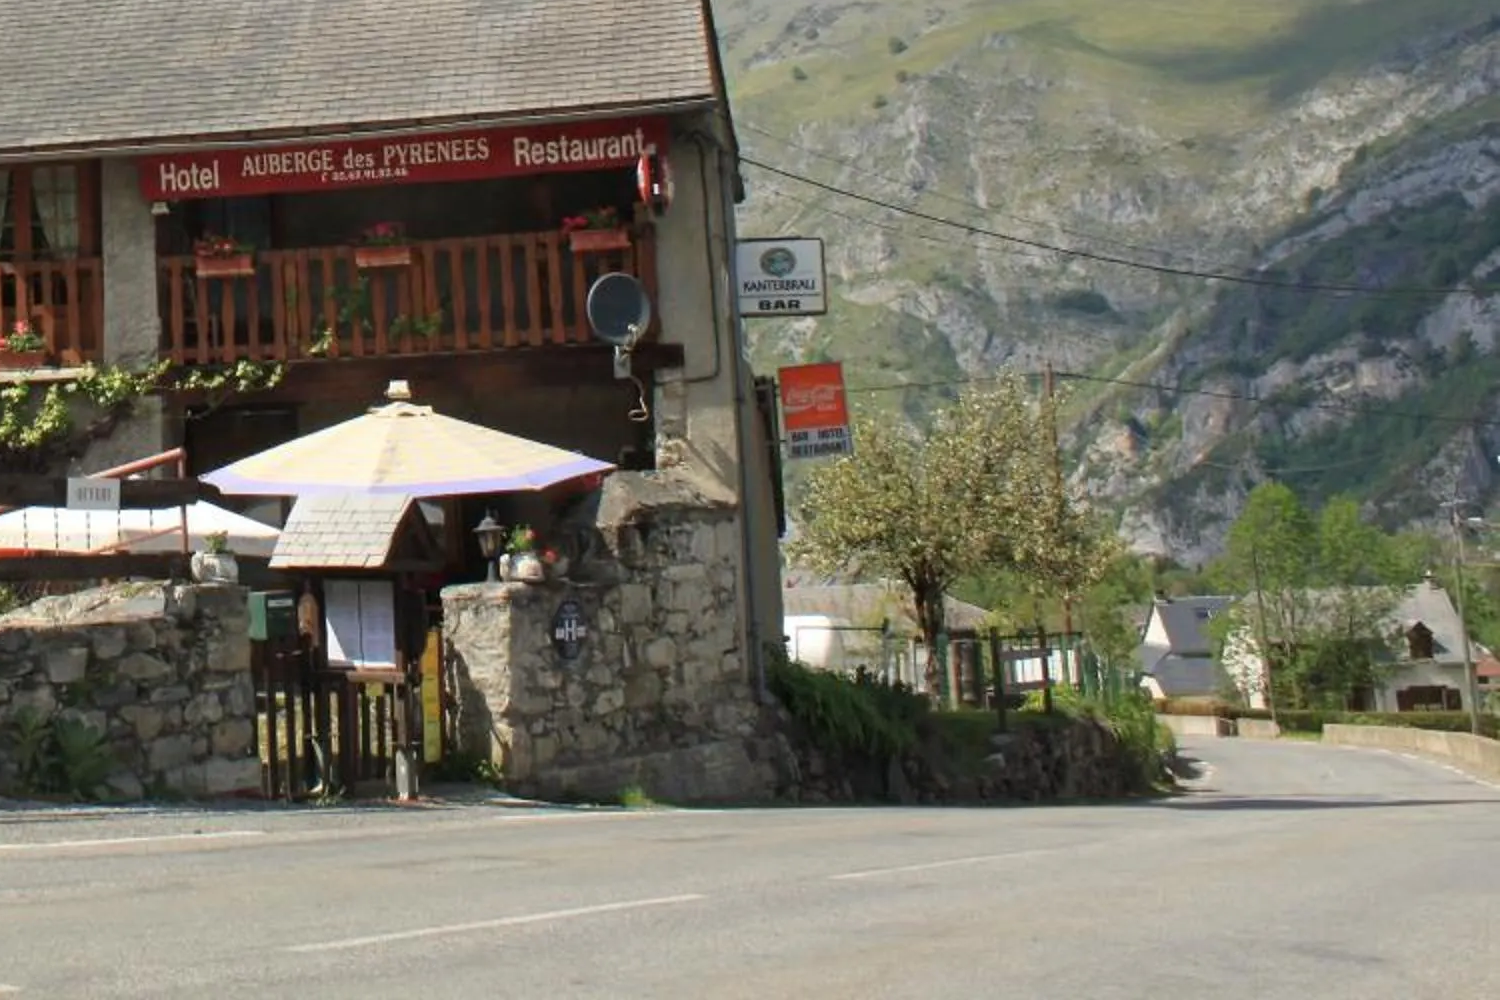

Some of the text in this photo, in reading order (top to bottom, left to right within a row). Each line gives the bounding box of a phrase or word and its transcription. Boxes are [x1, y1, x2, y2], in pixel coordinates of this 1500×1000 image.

[241, 137, 490, 177] AUBERGE des PYRENEES
[513, 127, 645, 166] Restaurant
[160, 160, 220, 192] Hotel
[758, 299, 801, 311] BAR
